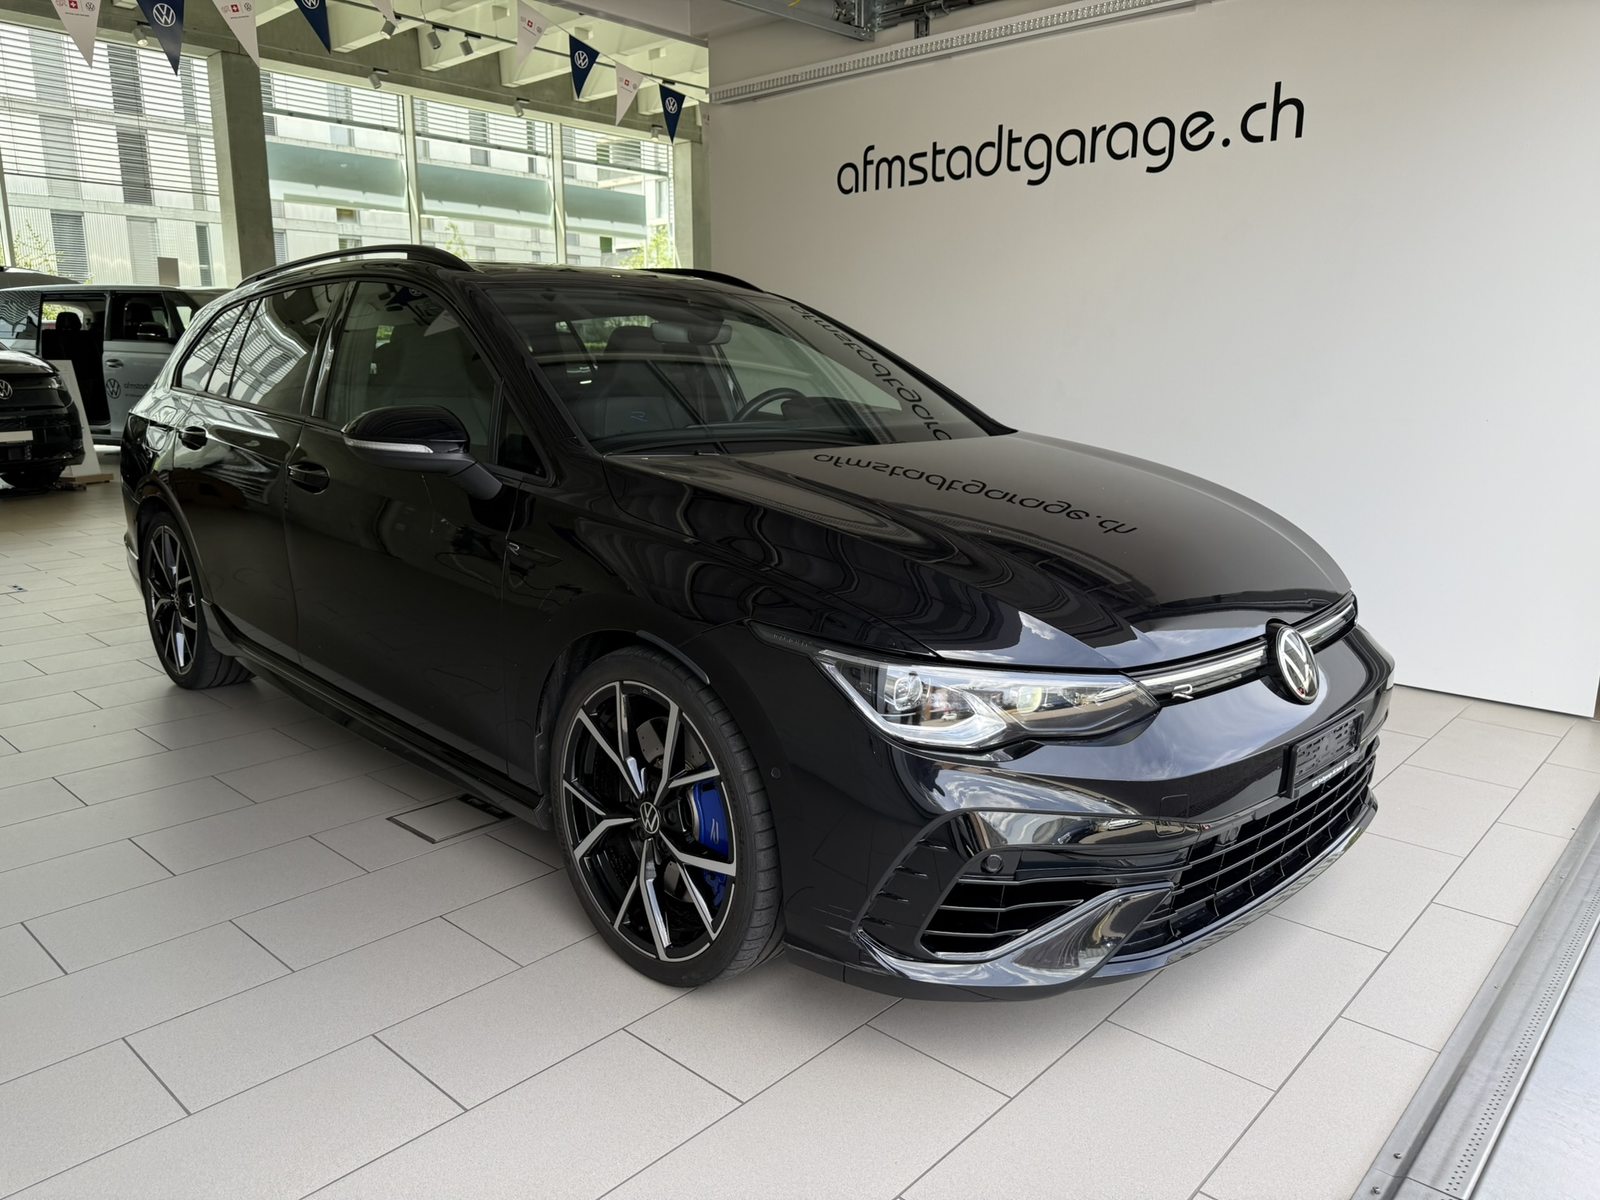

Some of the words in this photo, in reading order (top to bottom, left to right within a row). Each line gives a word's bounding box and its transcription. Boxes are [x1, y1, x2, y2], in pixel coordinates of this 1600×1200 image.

[836, 81, 1305, 195] afmstadtgarage.ch
[1172, 683, 1194, 700] R
[1277, 625, 1320, 701] VW
